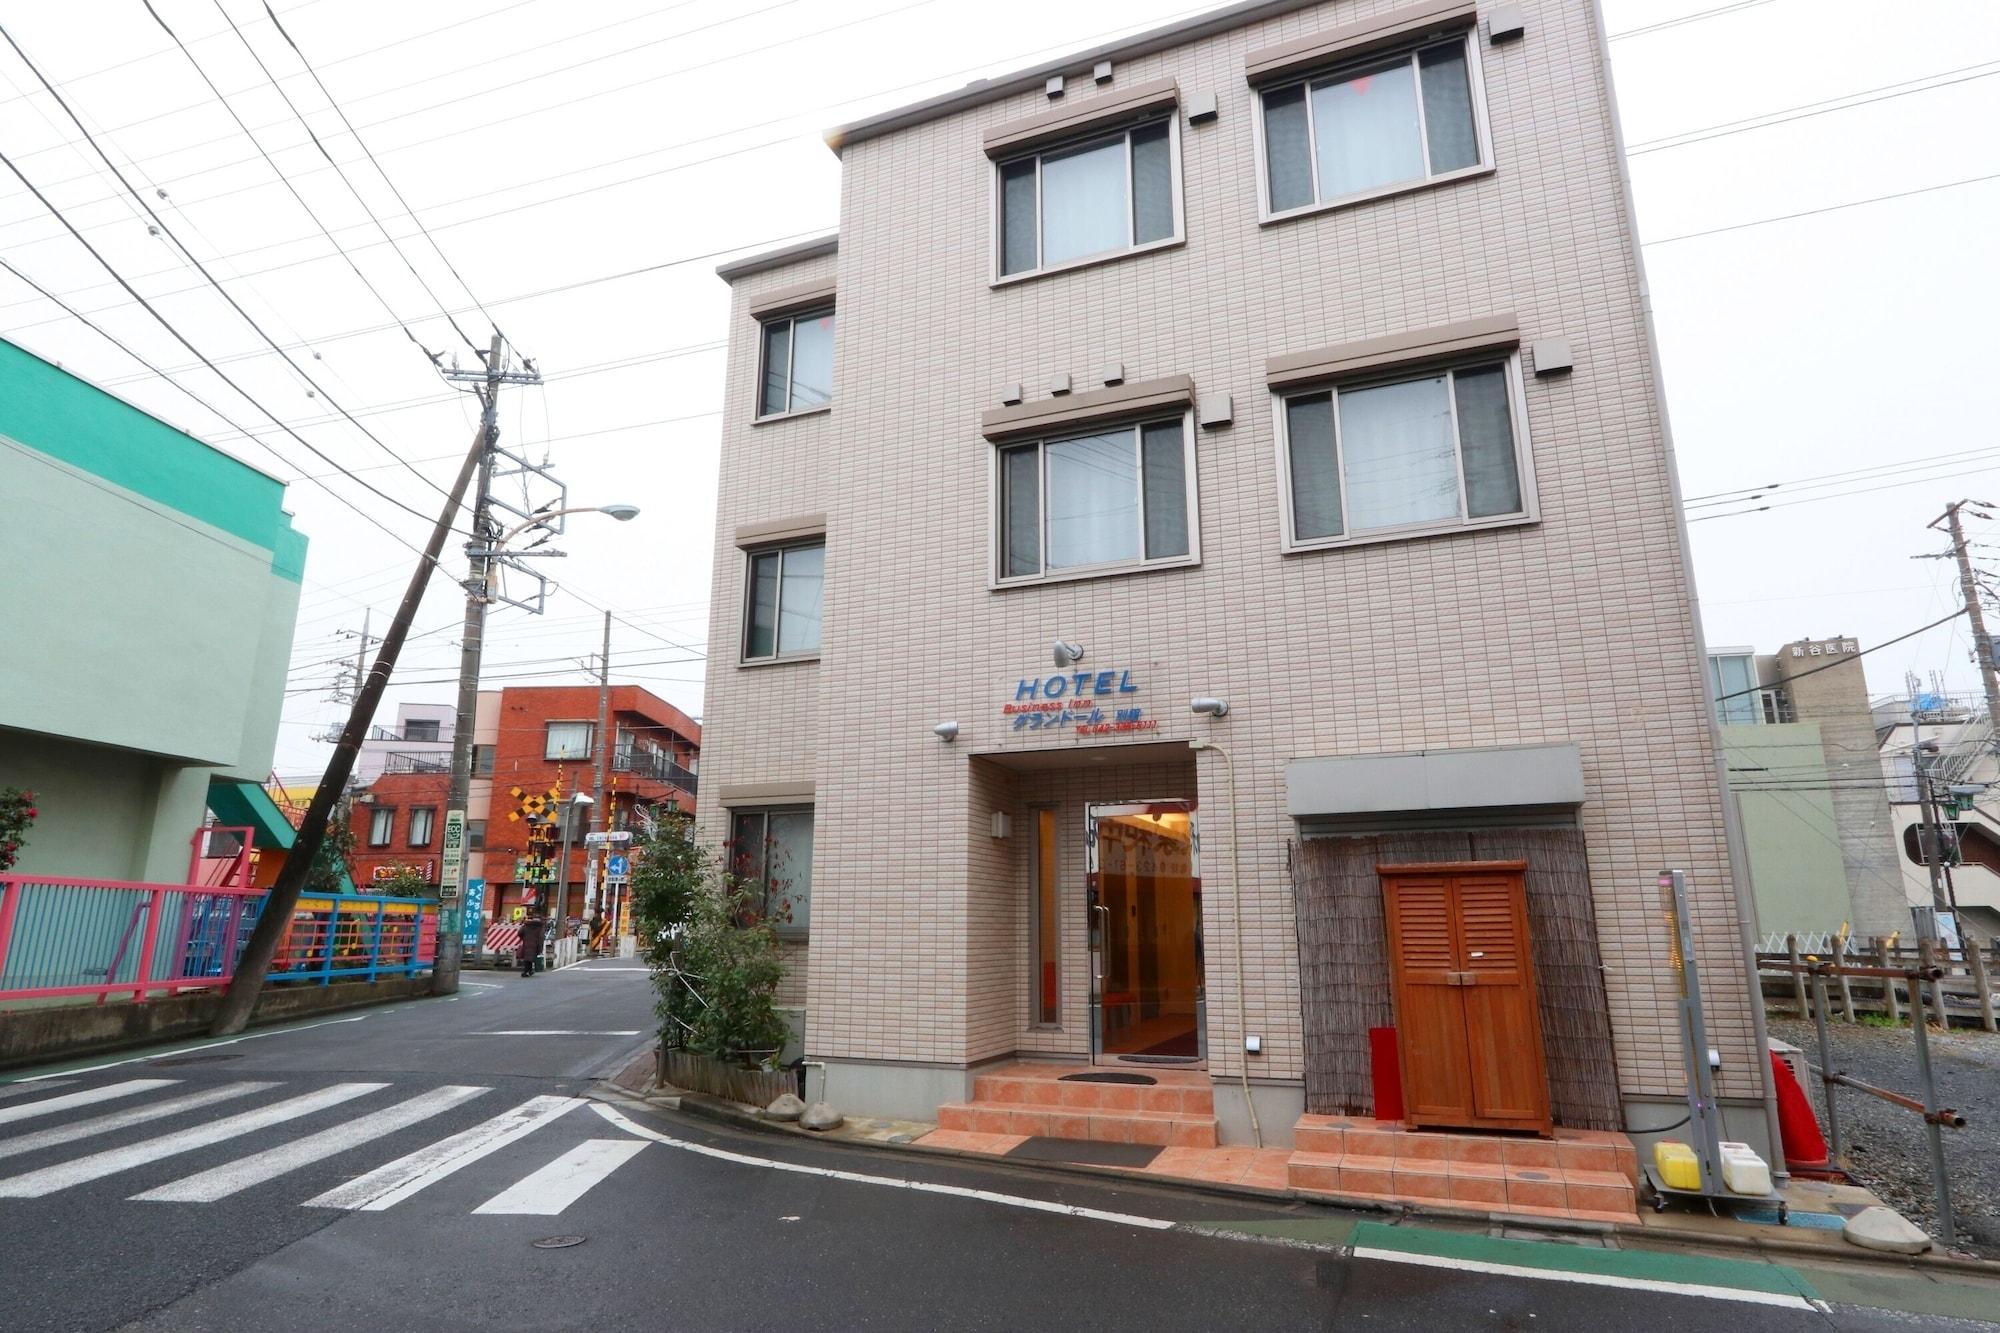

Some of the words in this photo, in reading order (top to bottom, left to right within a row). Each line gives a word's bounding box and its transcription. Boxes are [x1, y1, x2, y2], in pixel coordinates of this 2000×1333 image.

[1792, 642, 1856, 656] 新谷医院
[1015, 670, 1137, 700] HOTEL
[1003, 702, 1063, 714] Business
[1013, 708, 1105, 731] グランドール
[447, 825, 461, 833] ECC
